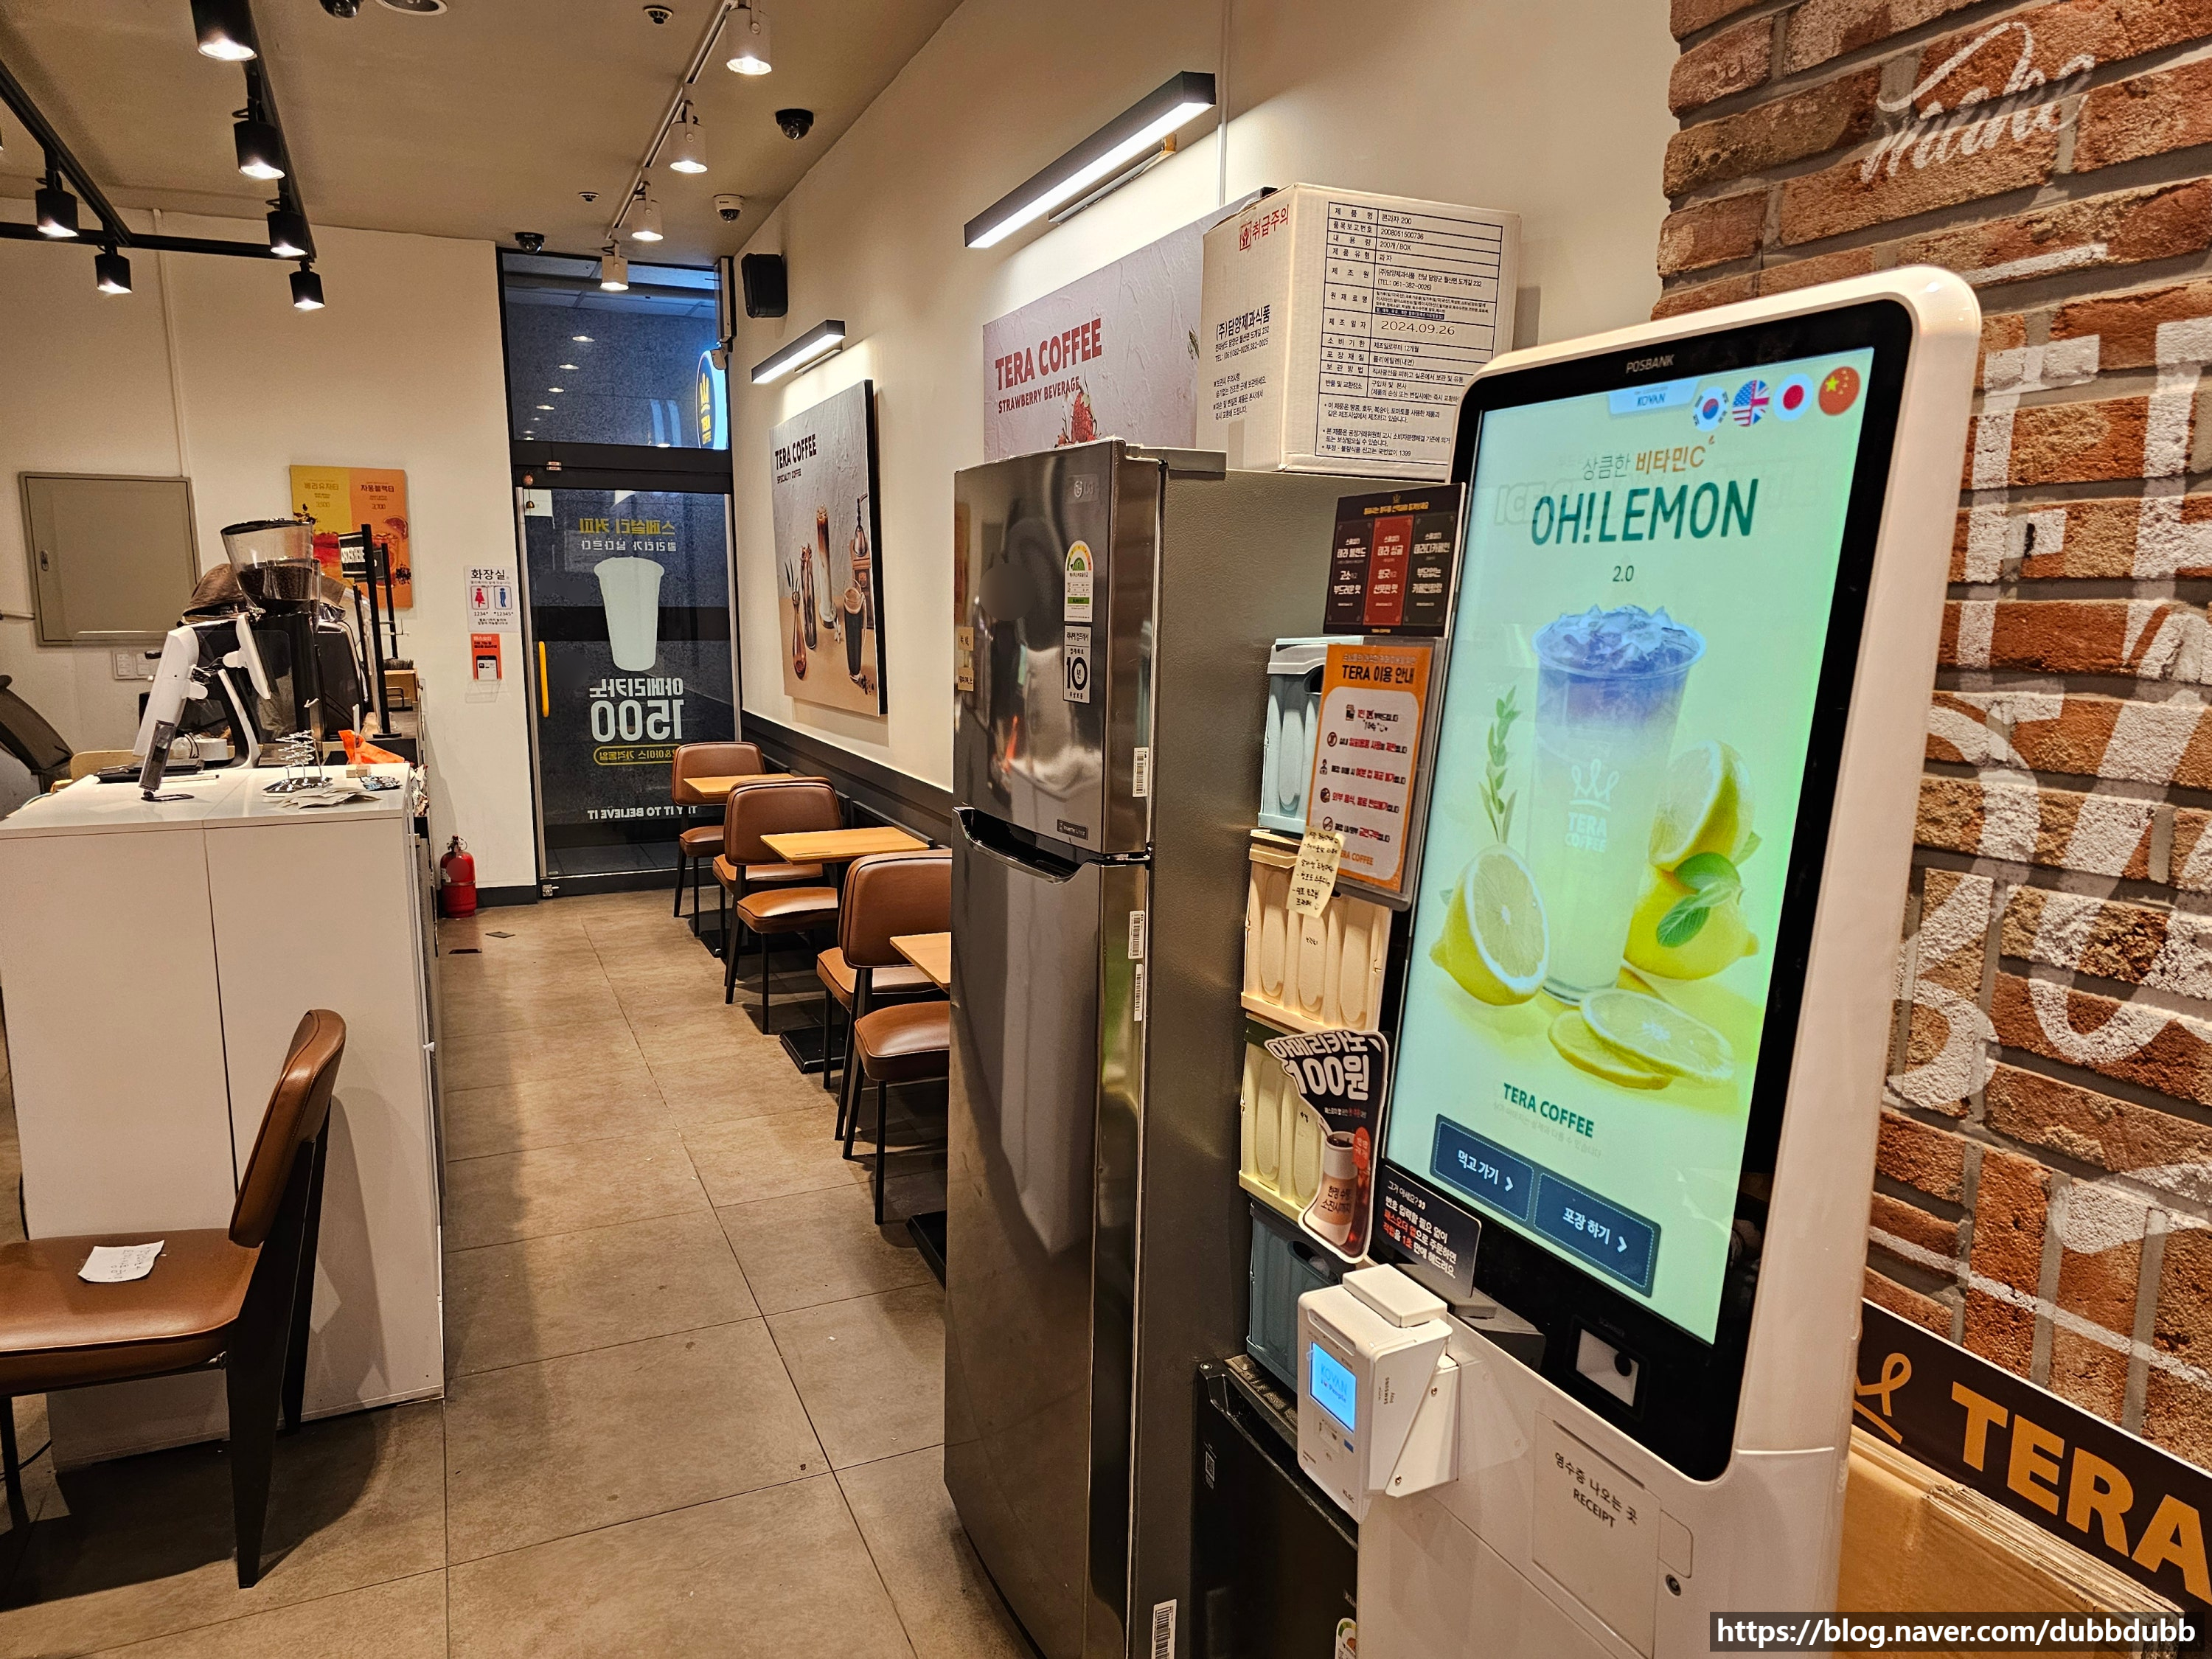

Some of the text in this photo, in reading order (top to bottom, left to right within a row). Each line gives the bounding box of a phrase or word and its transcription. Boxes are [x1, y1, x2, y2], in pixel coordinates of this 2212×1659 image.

[1253, 204, 1289, 241] 취급주의
[1382, 213, 1399, 223] 콘과자
[1216, 305, 1270, 341] (주)담양제과식품
[1381, 320, 1455, 335] 2024.09.26
[995, 317, 1102, 391] TERA COFFEE
[1404, 344, 1419, 353] 12개월
[1626, 354, 1674, 374] POSBANK
[998, 376, 1079, 414] STRAWBERRY BEVERAGE
[1436, 374, 1446, 382] 보관
[1637, 392, 1666, 407] KOVAN
[775, 433, 817, 470] TERA COFFEE
[1583, 445, 1706, 481] 상큼한 비타민C
[1531, 478, 1759, 546] OH!LEMON
[471, 568, 506, 580] 화장실
[1613, 565, 1635, 583] 2.0
[1066, 656, 1088, 691] 10
[1342, 664, 1416, 684] TERA 이용 안내
[1340, 849, 1374, 866] ERA COFFEE
[1267, 1031, 1368, 1058] 아메리카노
[1284, 1054, 1370, 1102] 100원
[1503, 1082, 1595, 1139] TERA COFFEE
[1458, 1149, 1500, 1185] 먹고 가기
[1328, 1185, 1340, 1200] 한정
[1384, 1208, 1457, 1265] 패스오더 앱으로 주문하면
[1385, 1195, 1448, 1244] 번호 입력할 필요 없이
[1562, 1206, 1611, 1245] 포장 하기
[1402, 1235, 1413, 1250] 1초
[1413, 1242, 1427, 1259] 만에
[1321, 1363, 1348, 1397] KOVAN
[1555, 1452, 1638, 1526] 영수증 나오는 곳
[1950, 1380, 2212, 1604] TERA
[1573, 1487, 1616, 1528] RECEIPT
